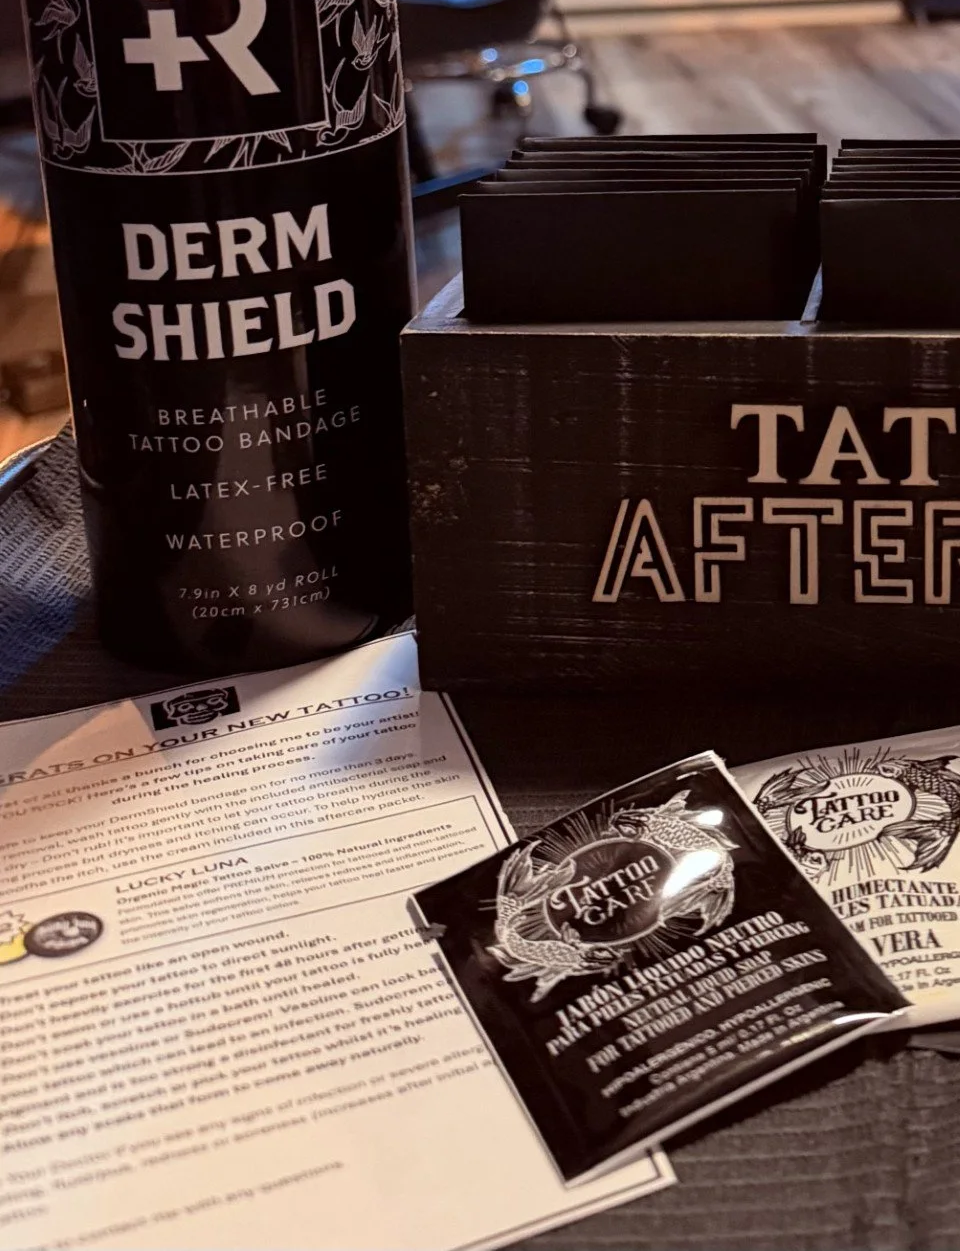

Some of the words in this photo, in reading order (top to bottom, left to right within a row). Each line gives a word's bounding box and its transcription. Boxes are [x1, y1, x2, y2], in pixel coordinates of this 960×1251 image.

[122, 204, 333, 281] DERM
[112, 279, 356, 360] SHIELD
[128, 433, 224, 453] TATTOO
[239, 405, 361, 450] BANDAGE
[158, 388, 328, 427] BREATHABLE
[170, 464, 328, 501] LATEX-FREE
[166, 510, 344, 550] WATERPROOF
[179, 585, 220, 600] 7.9in
[249, 583, 258, 595] 8
[266, 577, 287, 597] yd
[295, 565, 339, 586] ROLL
[192, 603, 246, 620] (20cm
[271, 586, 331, 612] 731cm)
[93, 748, 133, 764] ON
[143, 728, 217, 752] YOUR
[227, 710, 290, 732] NEW
[297, 686, 409, 715] TATTOO!
[66, 776, 117, 794] thanks
[135, 761, 181, 777] bunch
[185, 755, 206, 765] for
[209, 738, 277, 760] choosing
[280, 734, 301, 743] me
[306, 729, 319, 737] to
[323, 724, 340, 734] be
[344, 719, 373, 731] your
[379, 709, 419, 724] artist!
[153, 772, 180, 783] few
[184, 764, 212, 776] tips
[216, 760, 234, 768] on
[238, 747, 284, 765] taking
[287, 741, 318, 753] care
[322, 737, 335, 746] of
[340, 730, 370, 743] your
[373, 720, 415, 736] tattoo
[111, 787, 160, 805] during
[165, 781, 189, 792] the
[192, 766, 248, 787] healing
[252, 753, 315, 773] process.
[139, 818, 204, 840] important
[207, 814, 220, 823] to
[224, 810, 240, 820] let
[244, 804, 272, 817] your
[275, 794, 313, 808] tattoo
[317, 783, 365, 800] breathe
[369, 773, 408, 789] during
[411, 768, 430, 779] the
[82, 853, 104, 864] but
[109, 839, 162, 858] dryness
[166, 832, 191, 844] and
[195, 821, 240, 839] itching
[243, 817, 267, 827] can
[271, 807, 308, 821] occur.
[314, 802, 328, 811] To
[331, 795, 358, 809] help
[362, 784, 408, 802] hydrate
[411, 779, 431, 789] the
[434, 772, 460, 784] skin
[794, 789, 898, 824] TATTOO
[816, 804, 893, 832] CARE
[50, 872, 73, 884] the
[78, 864, 108, 878] itch,
[112, 859, 136, 869] use
[140, 851, 163, 862] the
[166, 841, 209, 856] cream
[212, 827, 271, 846] included
[290, 817, 313, 829] this
[317, 803, 374, 823] aftercare
[378, 792, 425, 810] packet.
[115, 870, 184, 893] LUCKY
[191, 855, 248, 876] LUNA
[116, 887, 168, 906] Organic
[171, 877, 209, 893] Magic
[213, 871, 251, 885] Tattoo
[254, 859, 288, 873] Salve
[302, 849, 333, 863] 100%
[338, 838, 381, 855] Natural
[385, 822, 451, 845] Ingredients
[547, 853, 659, 918] TATTOO
[832, 879, 957, 903] HUMECTANTE
[834, 898, 870, 918] LES
[705, 909, 784, 954] NEUTRO
[869, 914, 892, 928] FOR
[895, 911, 956, 923] TATTOOED
[870, 929, 942, 954] VERA
[545, 1020, 589, 1056] PARA
[589, 990, 645, 1026] PIELES
[645, 950, 727, 998] TATUADAS
[725, 945, 739, 960] Y
[739, 920, 810, 953] PIERCING
[585, 1043, 620, 1073] FOR
[616, 1005, 693, 1053] TATTOOED
[690, 988, 726, 1016] AND
[723, 961, 783, 1000] PIERCED
[781, 948, 827, 972] SKINS
[621, 987, 690, 1031] NEUTRAL
[688, 964, 738, 998] LIQUID
[735, 948, 773, 975] SOAP
